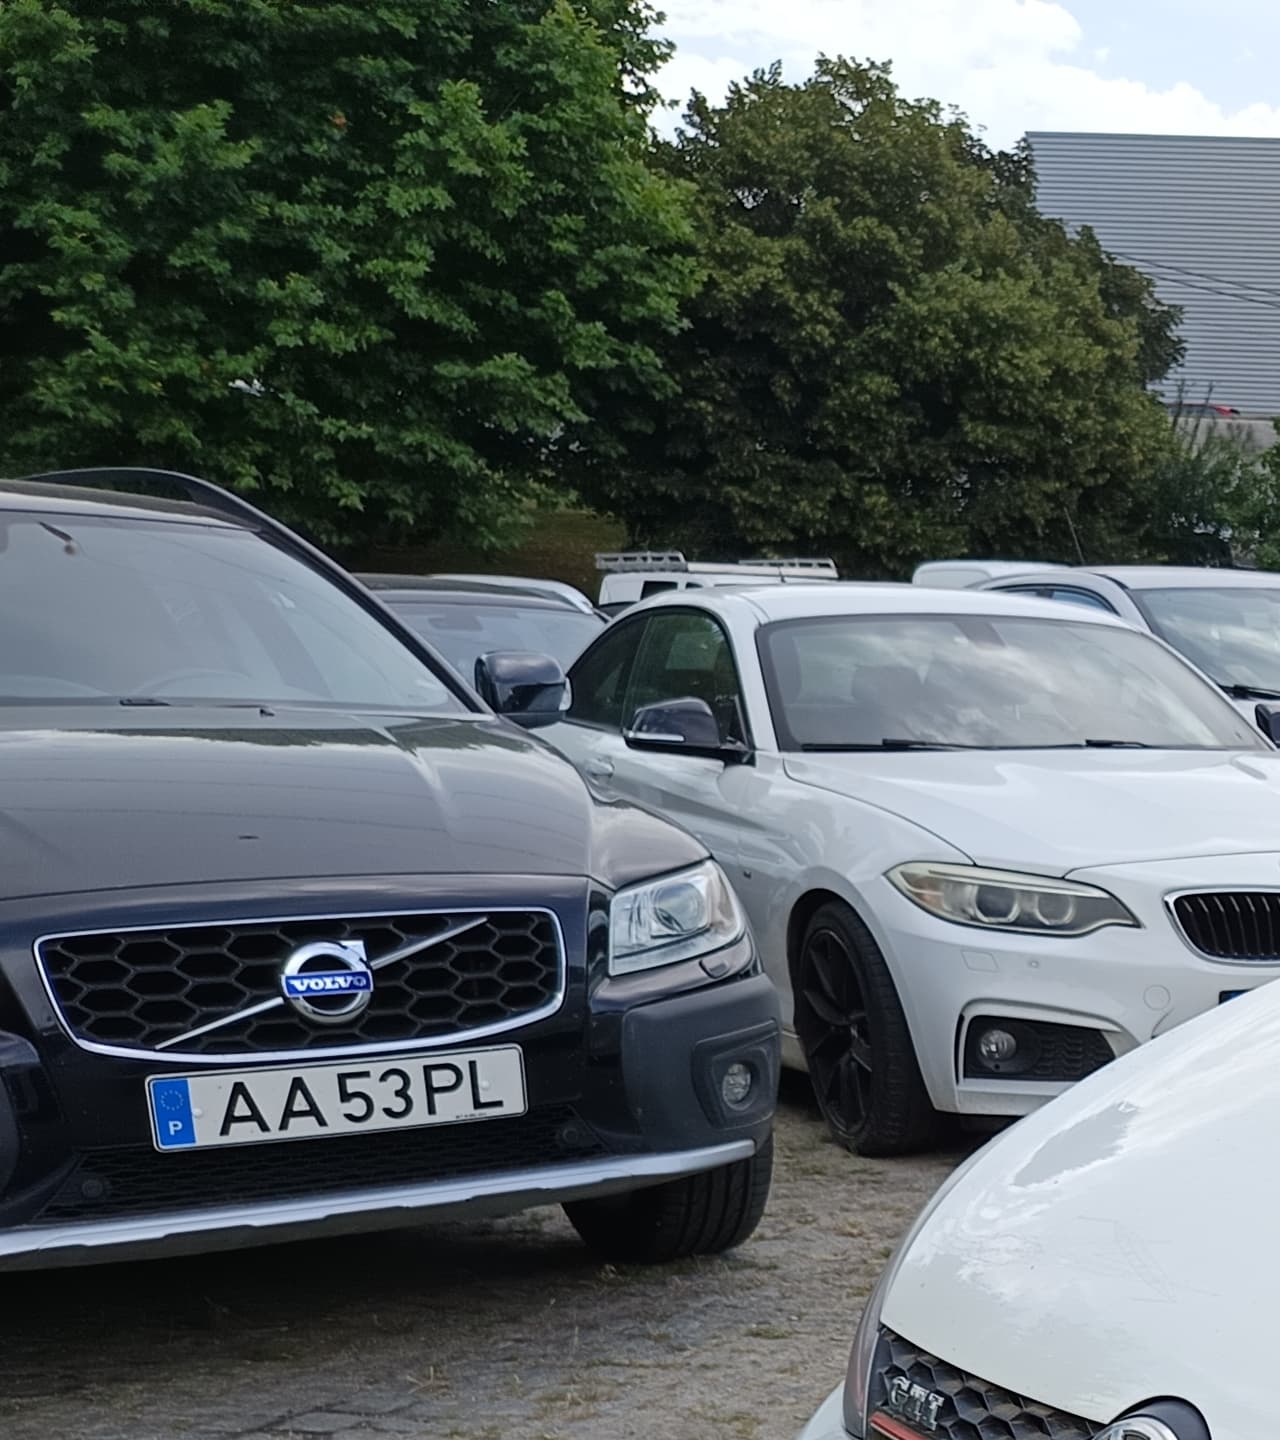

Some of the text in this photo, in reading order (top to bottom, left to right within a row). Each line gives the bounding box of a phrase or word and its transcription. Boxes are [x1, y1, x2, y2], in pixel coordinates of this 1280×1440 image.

[287, 975, 367, 992] VOLVO
[219, 1060, 504, 1136] AA53PL
[168, 1121, 183, 1136] P
